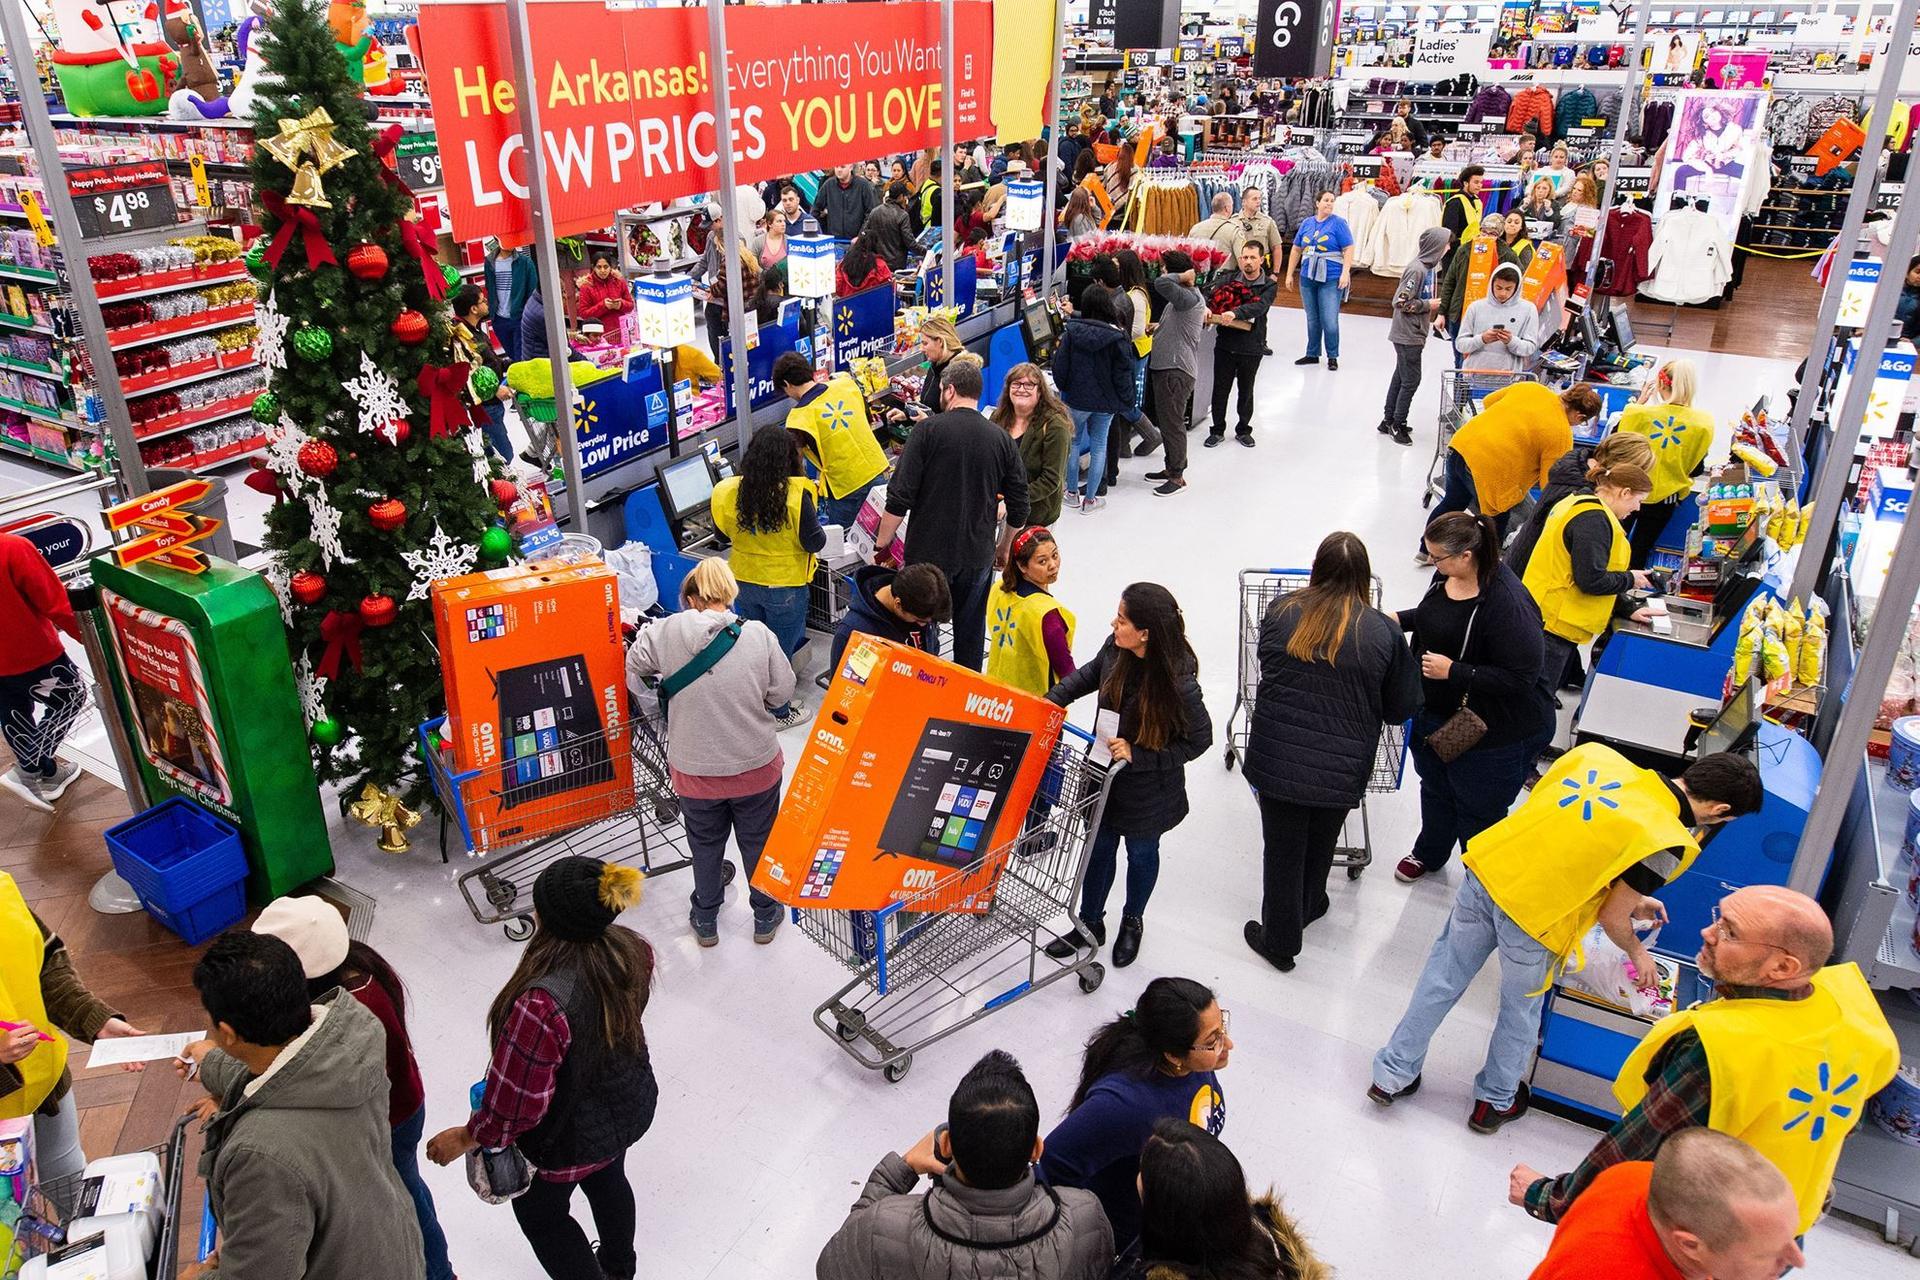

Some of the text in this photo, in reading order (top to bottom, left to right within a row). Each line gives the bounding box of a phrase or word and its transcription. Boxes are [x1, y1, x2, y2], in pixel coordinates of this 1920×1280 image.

[1099, 8, 1115, 17] Kitch
[1103, 17, 1115, 25] Dini
[1419, 38, 1459, 51] Ladies'
[1221, 46, 1241, 57] $199
[1417, 52, 1455, 64] Active
[1131, 53, 1149, 66] $69
[454, 38, 942, 118] He Arkansas! Everything You Want
[426, 139, 438, 148] Hap
[1293, 136, 1305, 144] $15
[1459, 133, 1474, 141] $15
[464, 83, 942, 207] LOW PRICES YOU LOVE
[412, 155, 441, 184] $99
[1353, 166, 1371, 176] $15
[71, 171, 164, 189] Happy Price. Happy Holidays.
[1616, 177, 1649, 190] $2196
[197, 185, 206, 193] H
[200, 196, 207, 205] 5
[1878, 195, 1900, 208] $12
[33, 224, 43, 233] H
[39, 236, 46, 244] 6
[788, 243, 815, 253] Scan&Go
[58, 268, 69, 283] $2
[1848, 268, 1880, 278] n&Go
[637, 286, 664, 298] Scan&Go
[665, 284, 693, 297] Scan&Go
[838, 336, 859, 349] Everyday
[839, 336, 885, 365] Low Price
[758, 377, 775, 397] Pri
[577, 433, 607, 451] Everyday
[579, 427, 650, 470] Low Price
[141, 496, 171, 513] Candy
[46, 538, 70, 556] your
[155, 535, 176, 548] Toys
[532, 536, 541, 546] 2
[604, 583, 614, 607] onn.
[609, 632, 617, 645] TV
[123, 628, 180, 664] Two ways to talk
[128, 645, 137, 656] to
[137, 648, 148, 662] the
[149, 654, 161, 671] big
[161, 660, 180, 677] man!
[892, 661, 949, 688] onn. Roku TV
[604, 684, 624, 742] watch
[964, 692, 1014, 724] watch
[479, 722, 496, 763] onn.
[817, 728, 846, 751] onn.
[158, 769, 242, 824] Days until Christmas
[957, 798, 972, 808] VUDU
[902, 868, 937, 889] onn.
